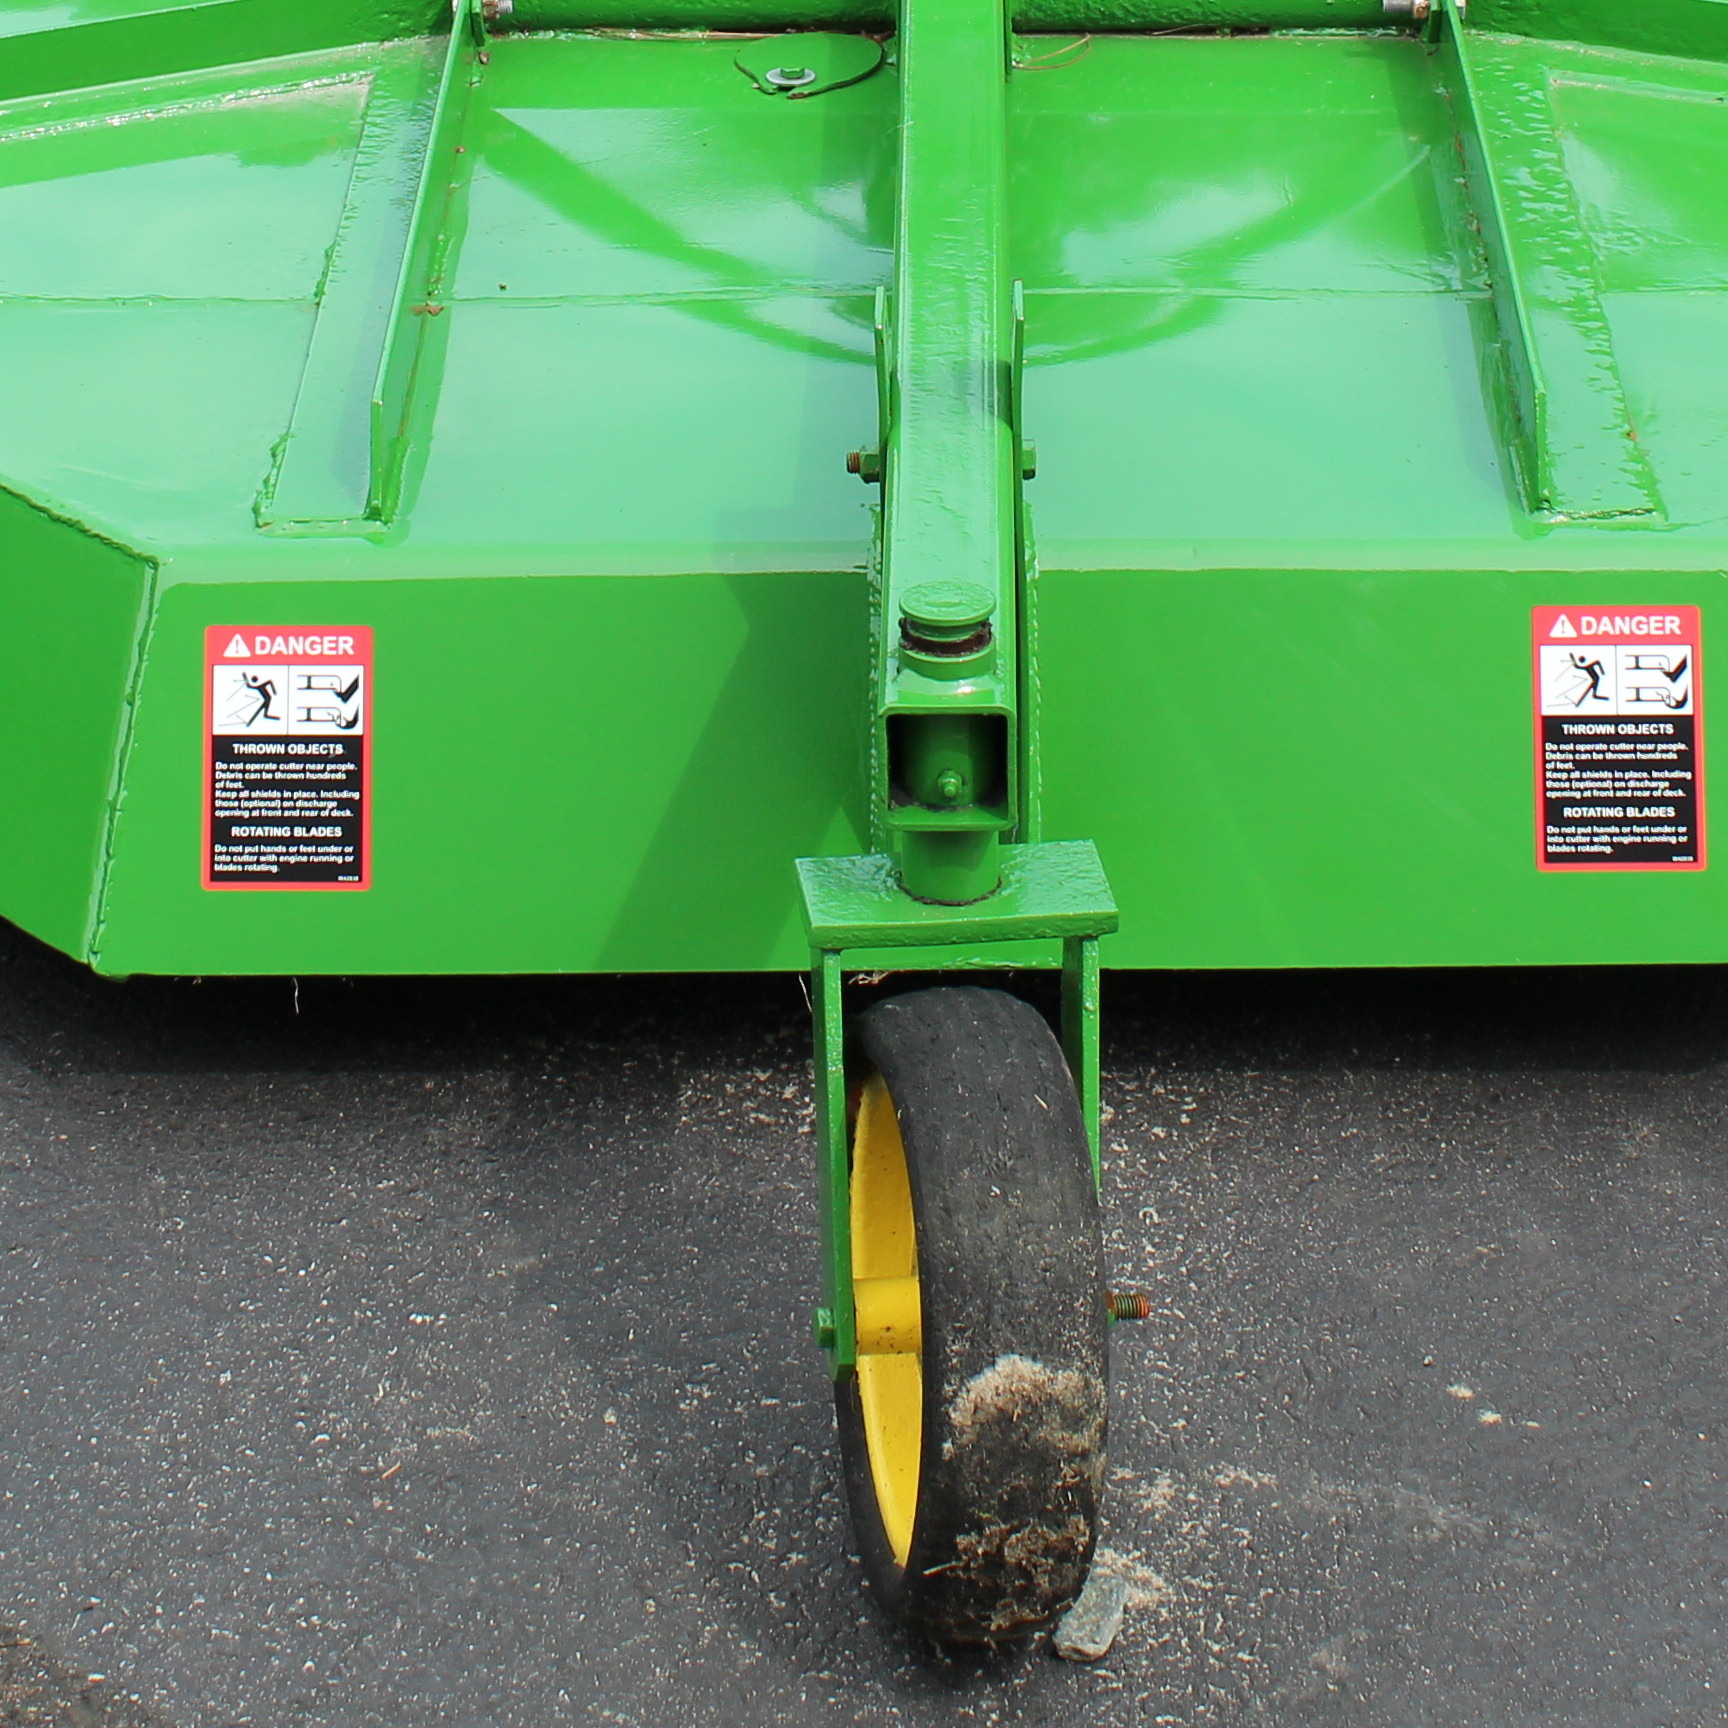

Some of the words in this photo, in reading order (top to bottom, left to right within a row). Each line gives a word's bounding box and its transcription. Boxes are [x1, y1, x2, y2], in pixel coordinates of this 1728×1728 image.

[1581, 616, 1681, 635] DANGER
[254, 636, 354, 655] DANGER
[1562, 724, 1615, 734] THROWN
[1618, 724, 1674, 734] OBJECTS
[233, 744, 285, 754] THROWN
[287, 744, 344, 754] OBJECTS
[1575, 743, 1608, 751] operate
[1657, 743, 1688, 751] people.
[216, 762, 228, 770] Do
[229, 762, 243, 770] not
[245, 762, 277, 771] operate
[279, 762, 304, 770] cutter
[326, 762, 357, 771] people.
[1546, 771, 1568, 779] Keep
[1627, 780, 1669, 789] discharge
[215, 790, 237, 800] Keep
[239, 790, 249, 798] all
[251, 790, 281, 798] shields
[283, 790, 291, 798] in
[1546, 789, 1581, 799] opening
[1583, 789, 1591, 797] at
[1593, 789, 1614, 797] front
[1615, 789, 1632, 797] and
[1652, 789, 1662, 797] of
[296, 800, 337, 809] discharge
[215, 809, 249, 818] opening
[1564, 807, 1624, 817] ROTATING
[1626, 807, 1675, 817] BLADES
[231, 826, 291, 837] ROTATING
[294, 826, 342, 837] BLADES
[1577, 826, 1592, 834] put
[1547, 835, 1564, 843] into
[1566, 835, 1590, 843] cutter
[1593, 835, 1611, 843] with
[1612, 835, 1641, 845] engine
[1643, 835, 1677, 845] running
[244, 845, 259, 853] put
[1547, 844, 1576, 852] blades
[1578, 844, 1613, 853] rotating.
[215, 854, 231, 862] into
[233, 854, 257, 862] cutter
[259, 854, 277, 862] with
[279, 854, 308, 864] engine
[310, 854, 343, 864] running
[244, 864, 279, 873] rotating.
